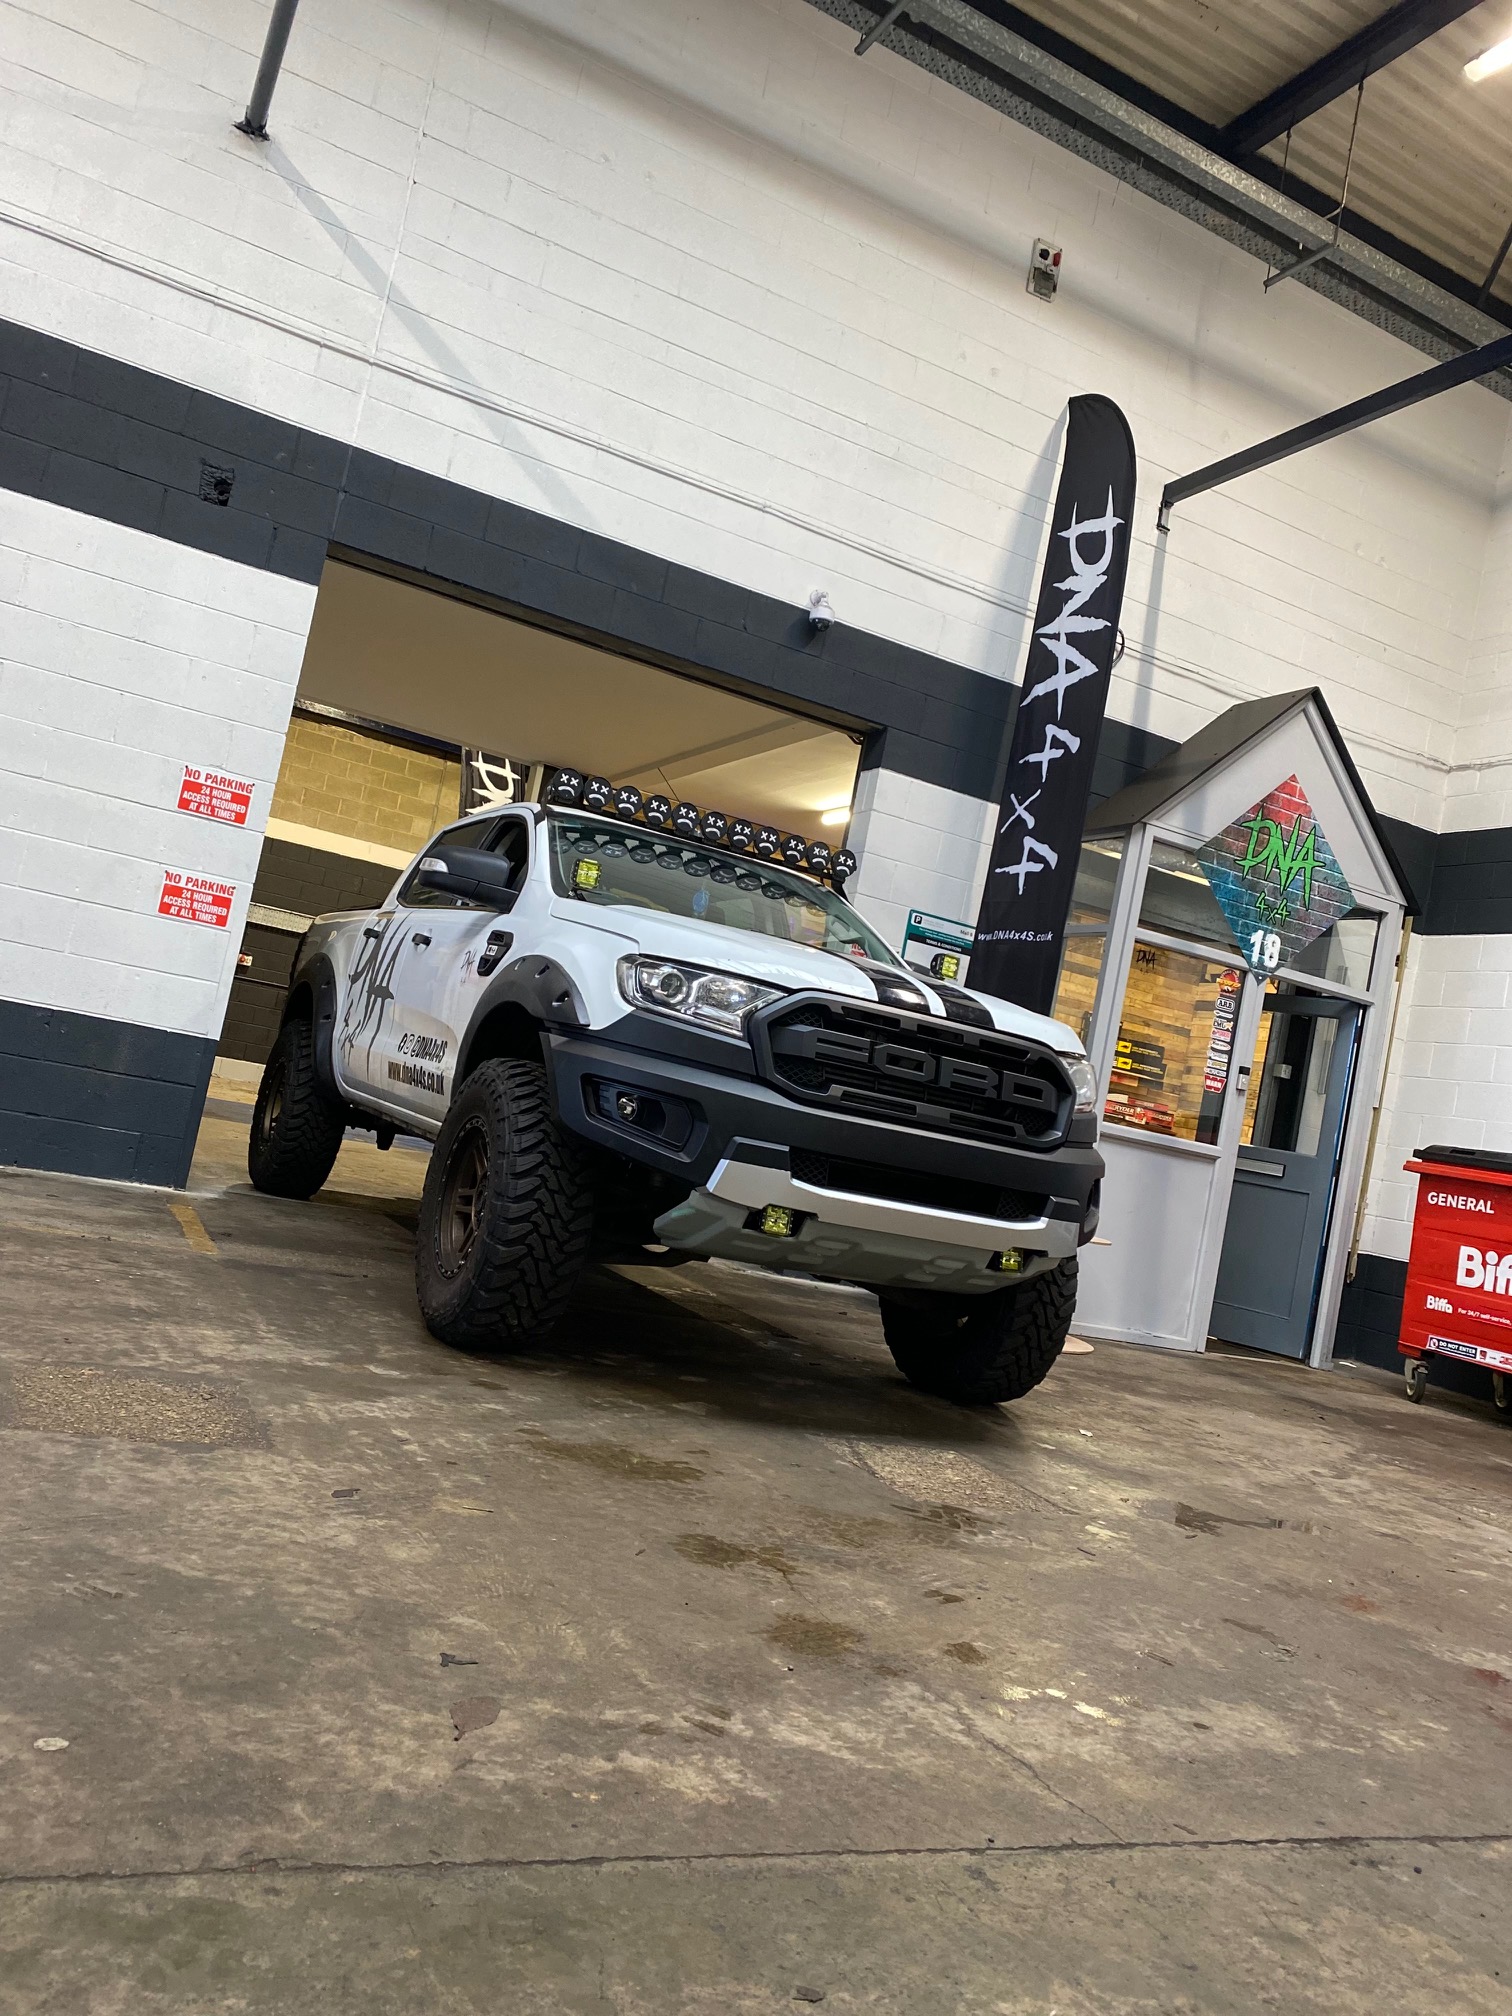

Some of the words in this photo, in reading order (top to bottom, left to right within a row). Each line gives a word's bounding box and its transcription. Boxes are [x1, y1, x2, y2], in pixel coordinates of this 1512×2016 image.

[1020, 484, 1125, 720] DNA
[184, 767, 201, 780] NO
[205, 775, 253, 794] PARKING
[465, 751, 521, 814] DN
[182, 791, 210, 804] ACCESS
[212, 798, 246, 813] REQUIRED
[201, 785, 210, 795] 24
[212, 788, 232, 801] HOUR
[188, 802, 198, 811] AT
[199, 804, 212, 815] ALL
[214, 808, 236, 820] TIMES
[995, 724, 1080, 895] 4x4
[1234, 802, 1326, 911] DNA
[165, 871, 182, 884] NO
[185, 876, 235, 896] PARKING
[163, 895, 191, 908] ACCESS
[192, 902, 227, 916] REQUIRED
[181, 889, 191, 898] 24
[193, 892, 213, 903] HOUR
[169, 906, 178, 915] AT
[179, 908, 193, 919] ALL
[195, 912, 217, 924] TIMES
[1254, 892, 1290, 927] 4x4
[1136, 948, 1158, 970] DNA
[1249, 929, 1281, 968] 18
[796, 1030, 1058, 1113] FORD
[1427, 1191, 1494, 1214] GENERAL
[1456, 1245, 1512, 1296] Bif
[1426, 1295, 1453, 1314] Biffa
[1459, 1346, 1476, 1354] ENTER
